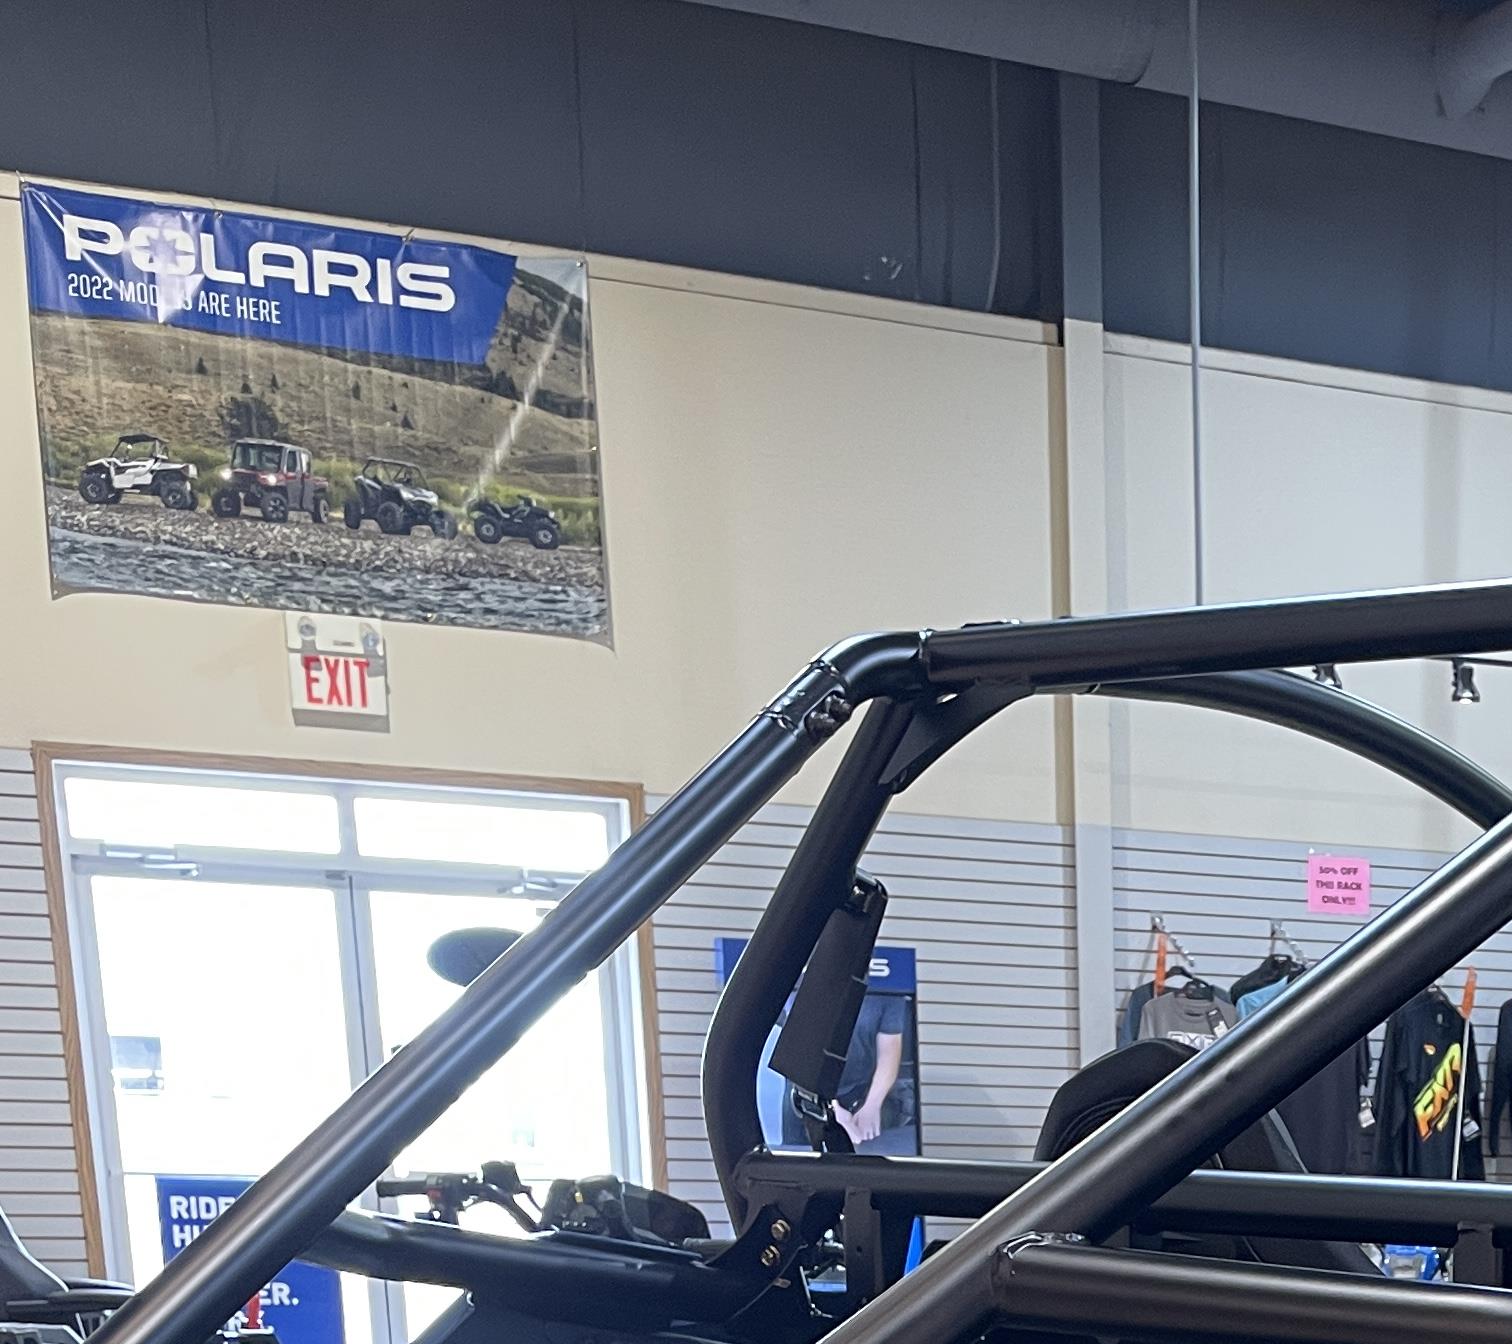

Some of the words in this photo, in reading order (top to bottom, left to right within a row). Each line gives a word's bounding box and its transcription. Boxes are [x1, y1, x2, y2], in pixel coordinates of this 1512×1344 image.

[62, 213, 456, 313] POLARIS
[67, 272, 113, 301] 2022
[198, 290, 232, 318] ARE
[237, 297, 282, 325] HERE
[303, 655, 369, 708] EXIT
